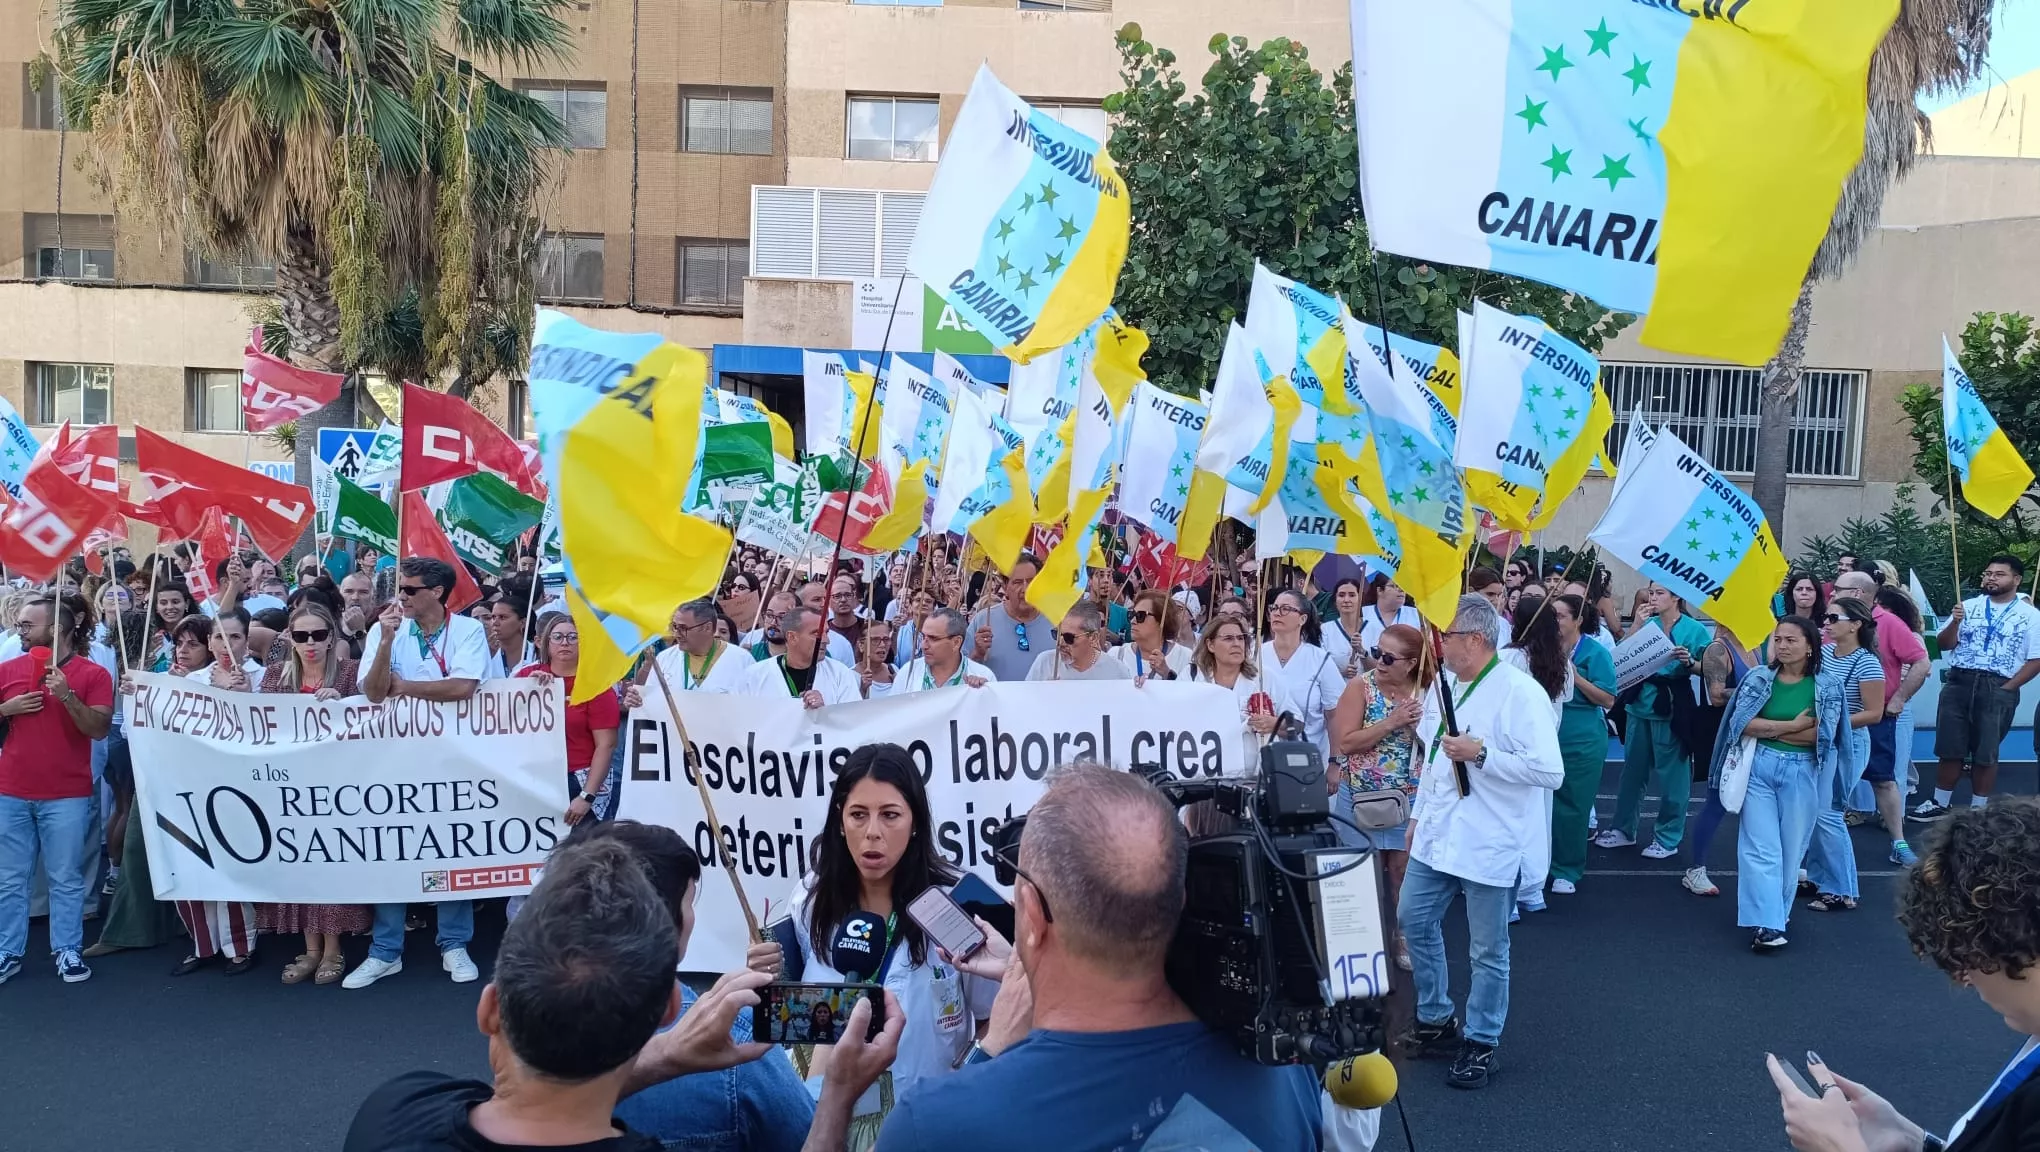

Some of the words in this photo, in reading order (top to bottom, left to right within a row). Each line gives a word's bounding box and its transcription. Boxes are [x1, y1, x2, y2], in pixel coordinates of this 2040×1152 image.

[1478, 191, 1659, 266] CANARI
[949, 269, 1036, 346] CANARIA
[1499, 326, 1596, 396] INTERSIND
[1676, 454, 1769, 556] INTERSINDICAL
[339, 516, 398, 556] SATS
[1641, 545, 1725, 602] CANARIA
[1613, 655, 1630, 667] DAD
[1630, 635, 1663, 658] LABORAL
[133, 685, 160, 728] EN
[161, 689, 245, 743] DEFENSA
[250, 706, 277, 745] DE
[291, 706, 332, 743] LOS
[336, 695, 444, 741] SERVICIOS
[457, 687, 555, 736] PÚBLICOS
[252, 768, 261, 782] a
[265, 763, 289, 782] los
[631, 719, 671, 782] El
[683, 732, 932, 799] esclaviso
[950, 715, 1111, 784] laboral
[1131, 730, 1224, 778] crea
[280, 779, 499, 817] RECORTES
[156, 785, 272, 870] NO
[278, 816, 558, 864] SANITARIOS
[695, 815, 812, 879] deteri
[455, 868, 524, 887] CCOO
[838, 941, 870, 954] CANARIA
